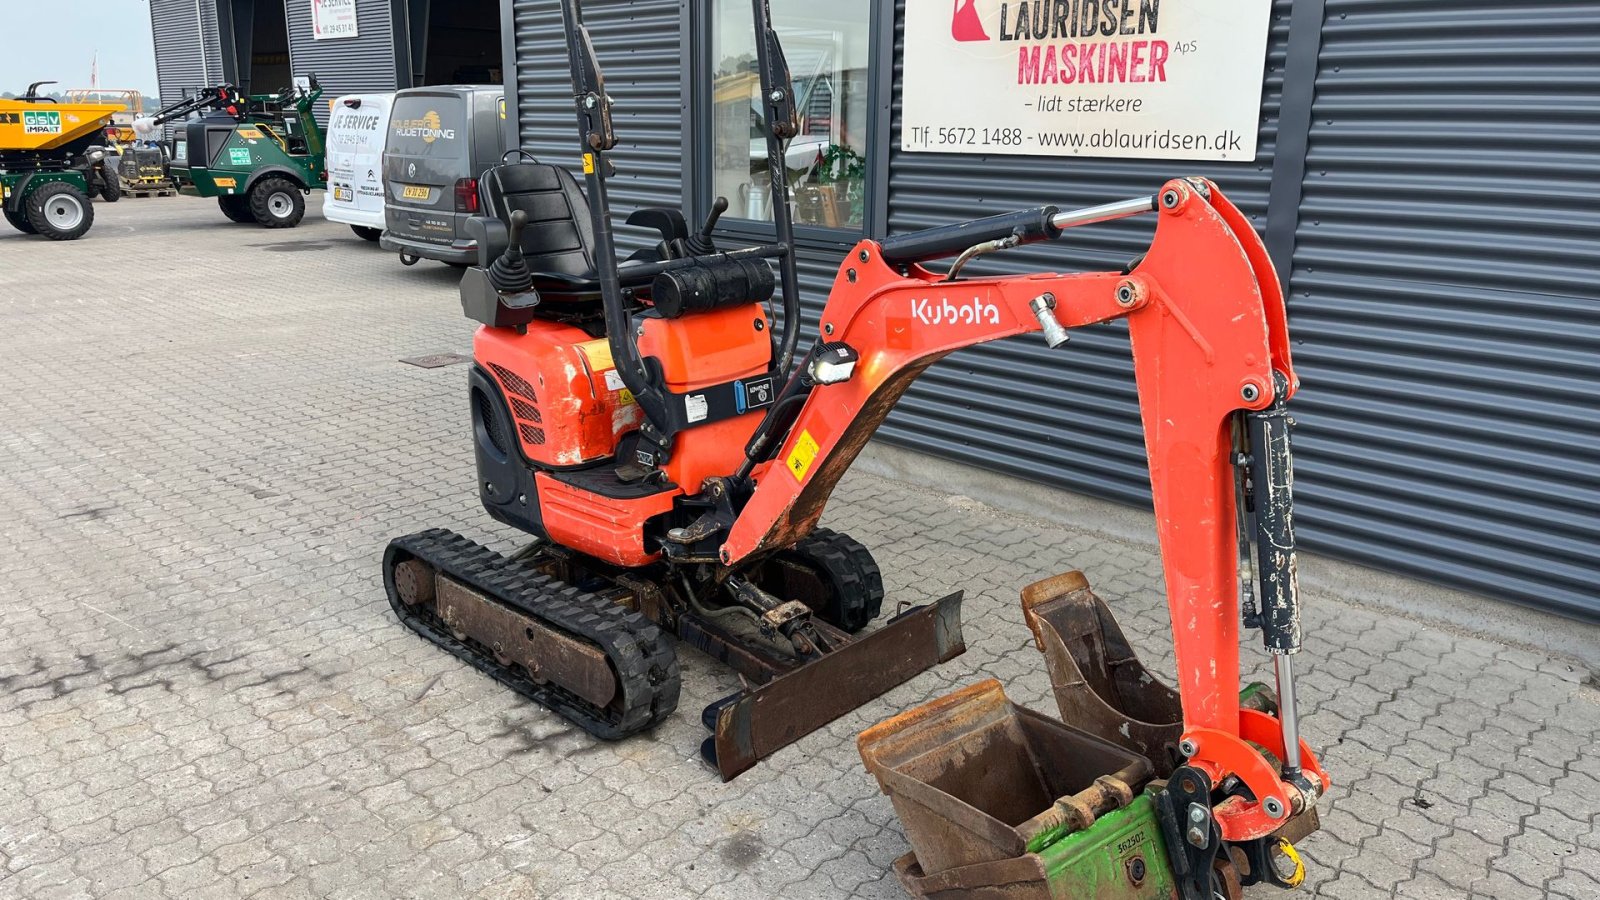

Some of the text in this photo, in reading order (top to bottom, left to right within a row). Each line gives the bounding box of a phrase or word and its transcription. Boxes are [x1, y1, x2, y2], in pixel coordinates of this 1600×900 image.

[1000, 0, 1160, 41] LAURIDSEN
[1018, 40, 1197, 84] MASKINER ApS
[1037, 95, 1062, 112] lidt
[1067, 95, 1143, 112] stærkere
[25, 115, 59, 125] GSV
[333, 115, 379, 130] JE SERVICE
[912, 126, 933, 148] Tlf.
[939, 127, 976, 144] 5672
[981, 128, 1022, 146] 1488
[1038, 128, 1241, 150] www.ablauridsen.dk
[911, 297, 1000, 325] Kubota
